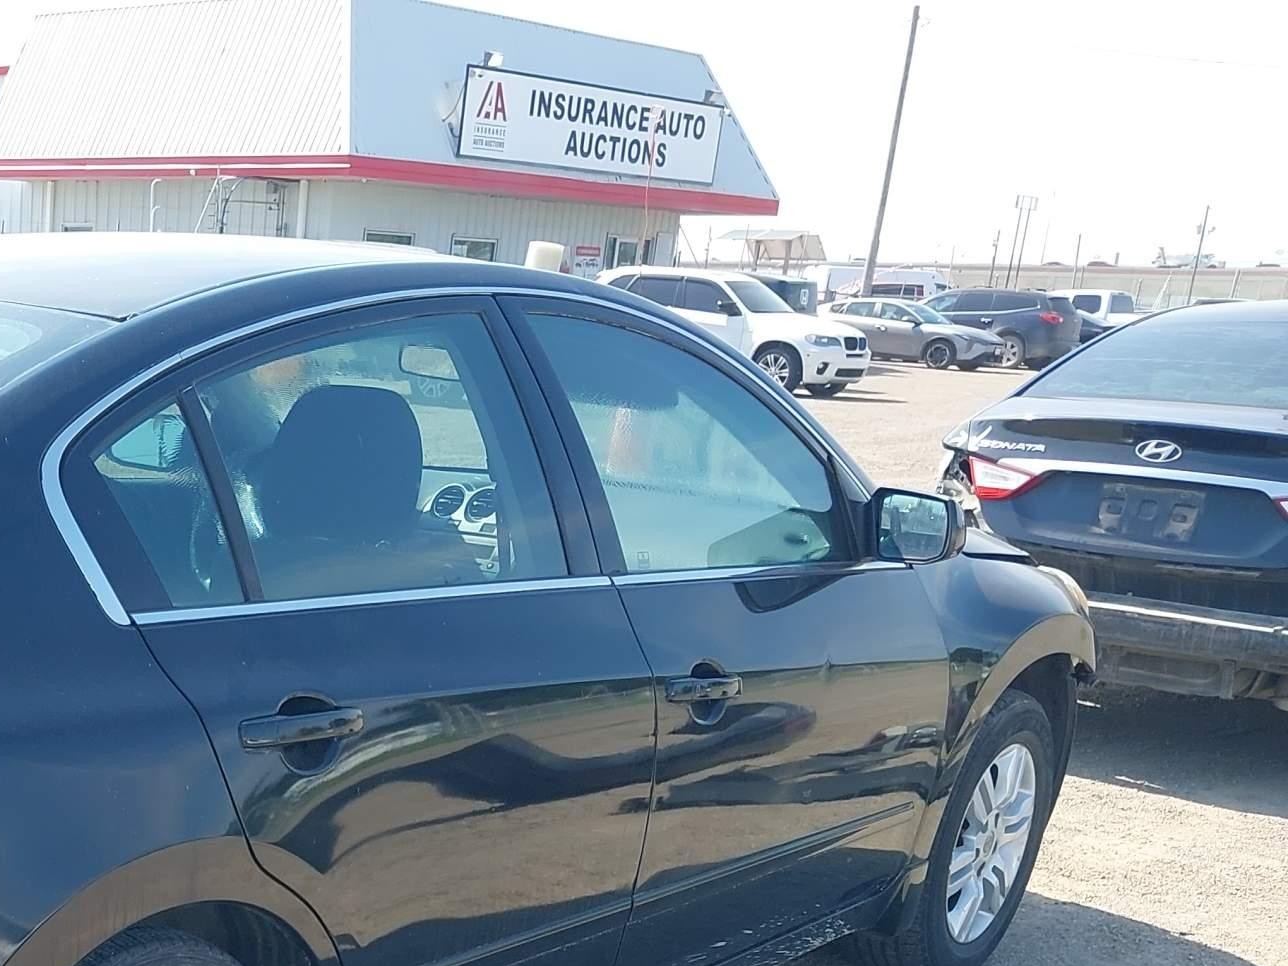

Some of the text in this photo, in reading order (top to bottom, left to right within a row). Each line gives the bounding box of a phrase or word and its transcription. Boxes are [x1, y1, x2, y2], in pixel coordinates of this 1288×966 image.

[529, 89, 706, 140] INSURANCE AUTO
[564, 130, 667, 167] AUCTIONS
[977, 440, 1046, 453] SONATA
